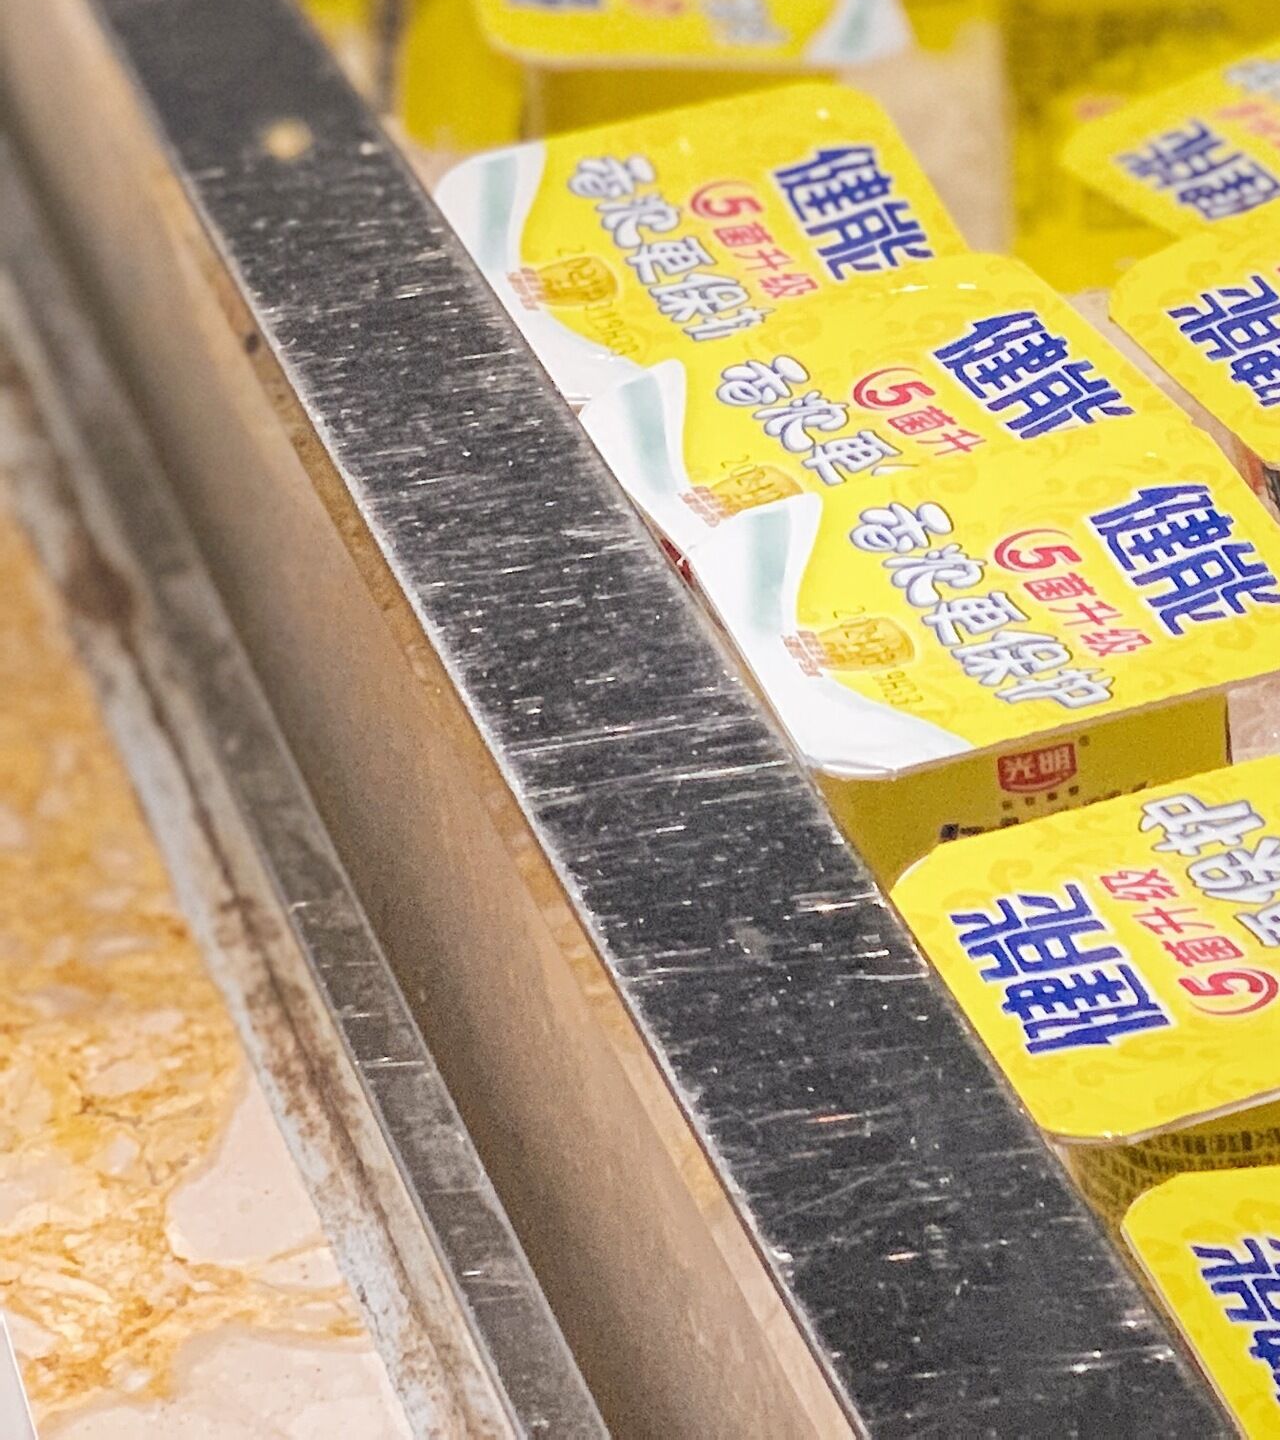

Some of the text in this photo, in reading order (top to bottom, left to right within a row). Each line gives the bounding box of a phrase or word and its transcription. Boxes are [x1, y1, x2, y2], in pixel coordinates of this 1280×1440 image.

[688, 178, 814, 302] 5菌升级
[775, 147, 935, 282] 健能
[934, 309, 1136, 442] 健能
[847, 499, 1122, 711] 香浓更保护
[992, 526, 1155, 659] 5菌升级
[1000, 746, 1080, 788] 光明
[950, 882, 1172, 1056] 健能
[1099, 866, 1280, 1019] 5菌升级
